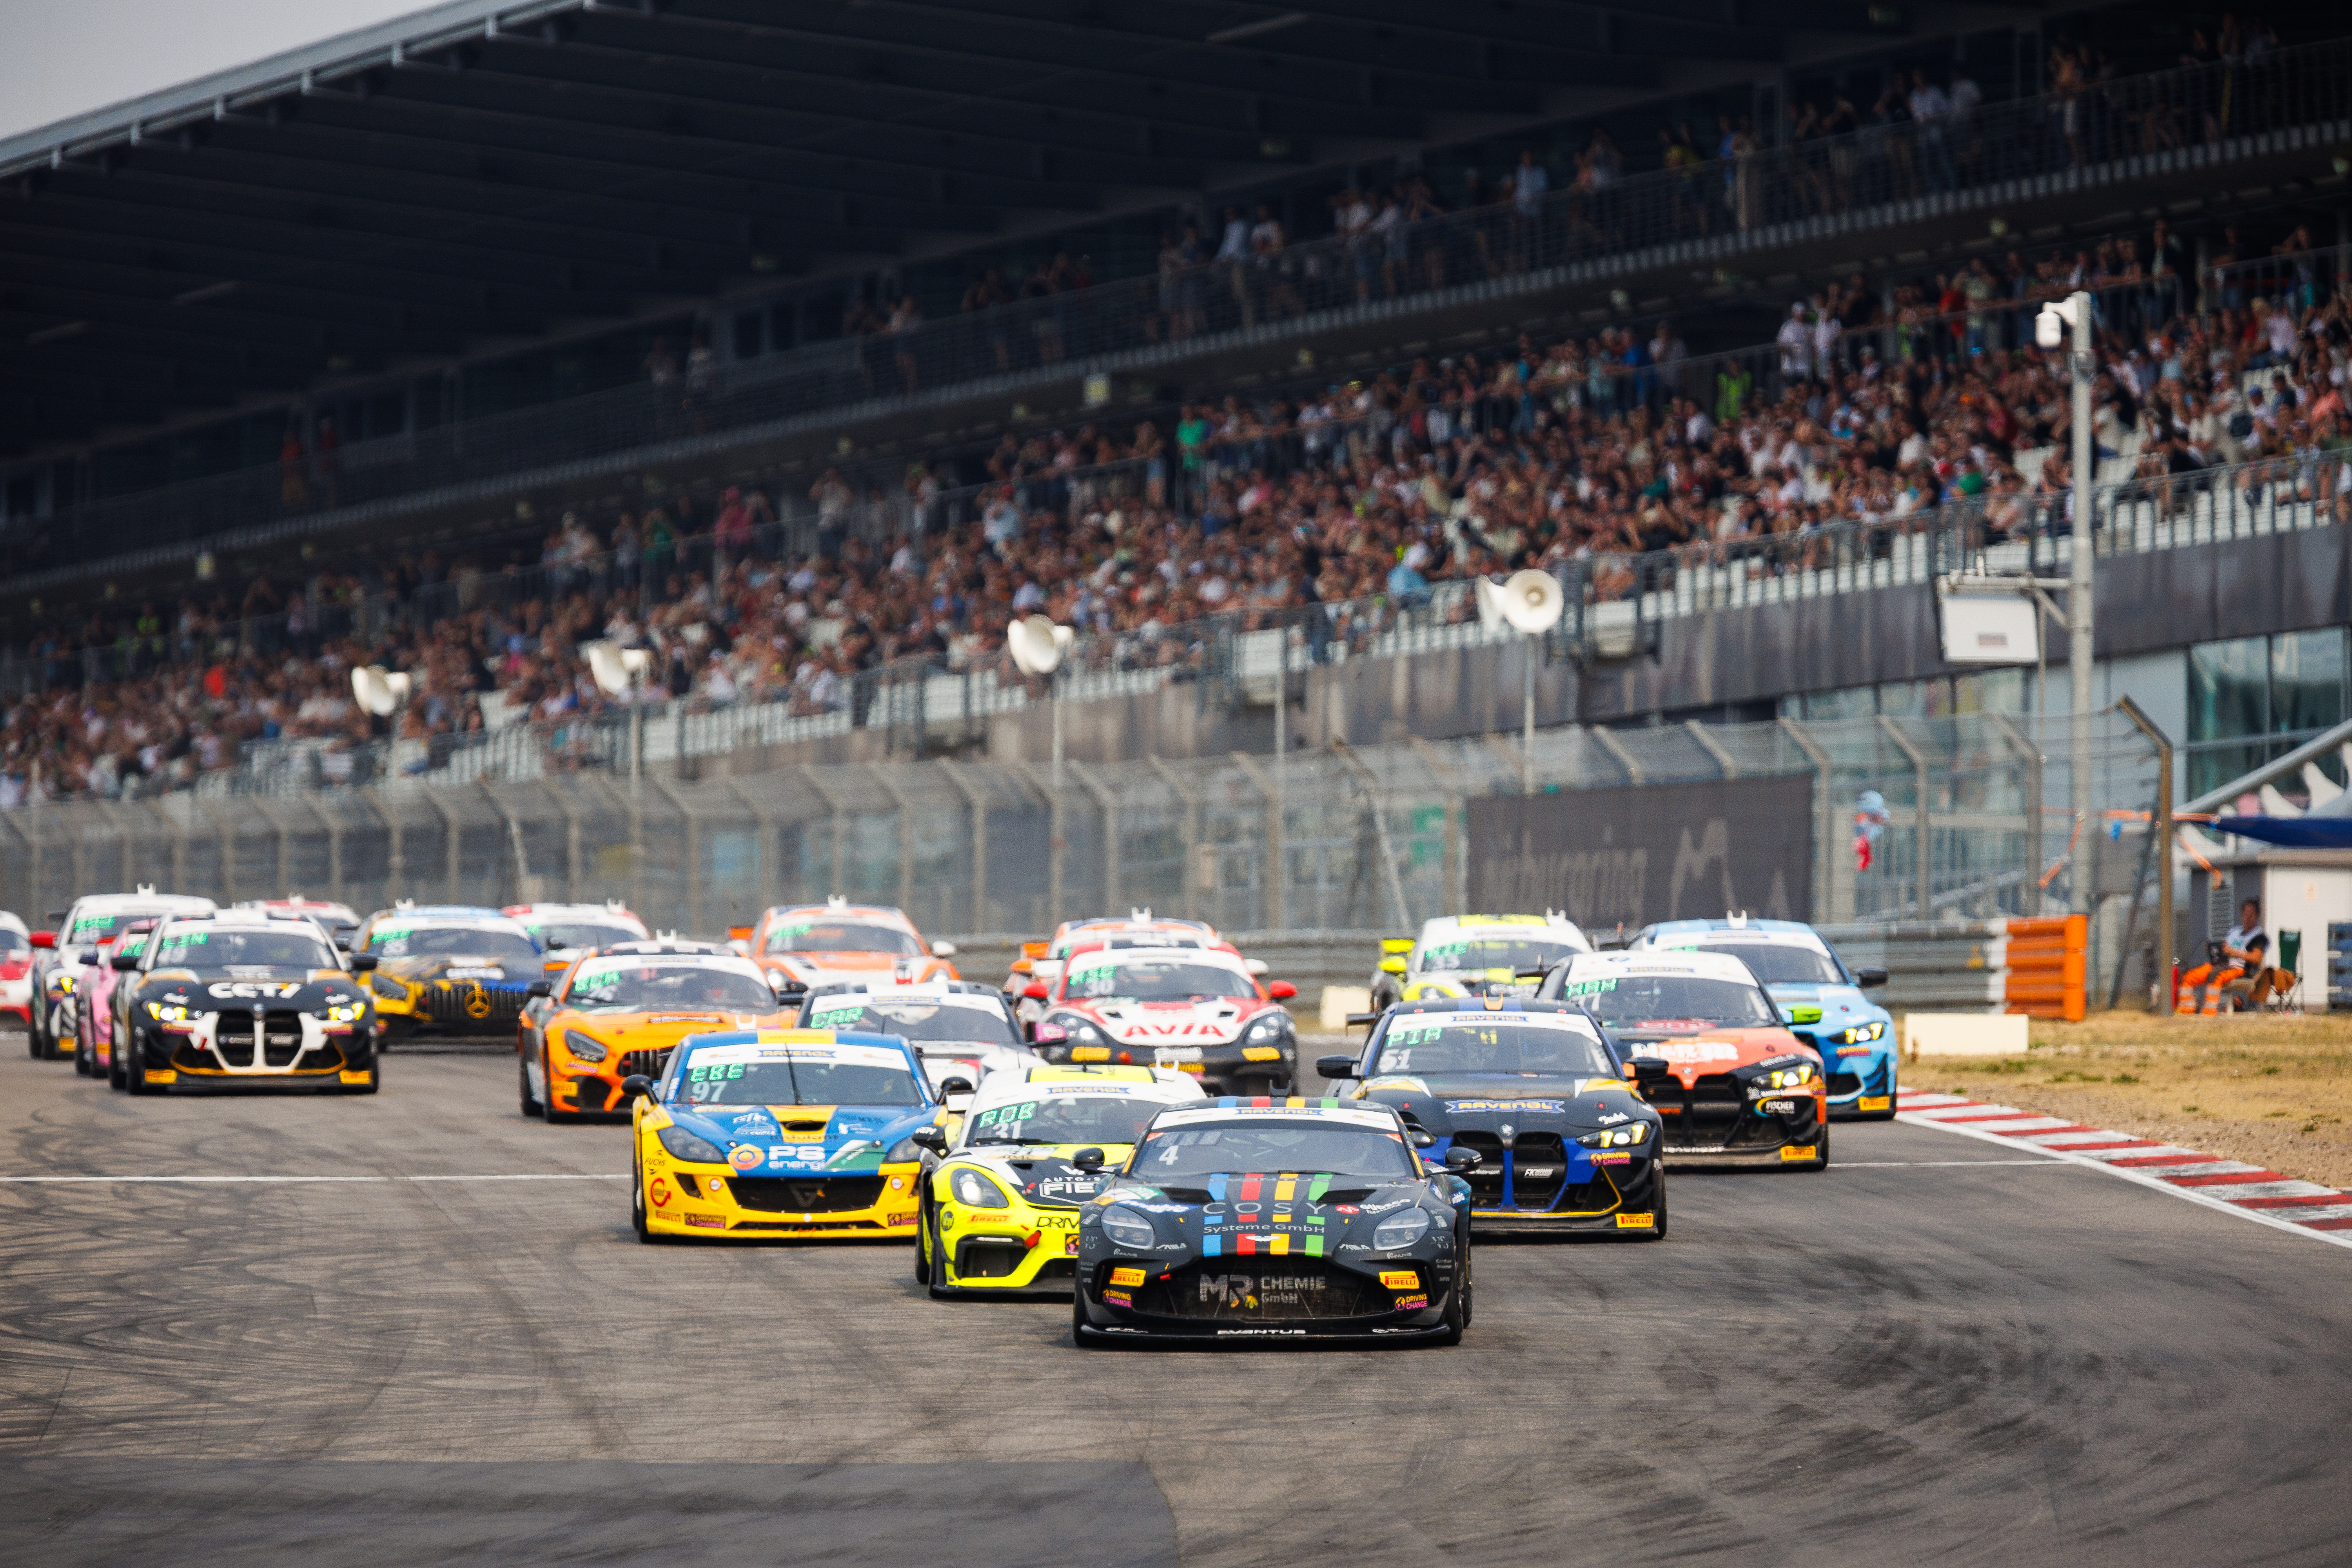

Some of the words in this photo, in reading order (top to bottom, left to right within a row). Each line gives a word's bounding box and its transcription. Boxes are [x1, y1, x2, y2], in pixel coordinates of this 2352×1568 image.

[1567, 978, 1617, 998] HAH
[811, 1007, 863, 1029] CAR
[1123, 1023, 1225, 1037] AVIA
[1387, 1027, 1442, 1047] PIA
[1378, 1049, 1412, 1073] 51
[691, 1081, 727, 1103] 97
[1458, 1101, 1553, 1110] RAVENOL
[1766, 1101, 1794, 1111] FISCHER
[979, 1102, 1036, 1128] ROB
[992, 1120, 1022, 1139] 31
[769, 1145, 826, 1161] PS
[1159, 1145, 1179, 1166] 4
[644, 1157, 666, 1167] FUCHS
[769, 1161, 825, 1171] energi
[1202, 1202, 1327, 1214] COSY
[656, 1210, 681, 1222] PIRELLI
[971, 1214, 1009, 1222] PIRELLI
[1620, 1215, 1651, 1224] PIRELLI
[695, 1220, 725, 1229] CHANGE
[1203, 1224, 1270, 1234] Systeme
[1275, 1224, 1325, 1233] GmbH
[1111, 1270, 1141, 1283] PIRELLI
[1385, 1275, 1416, 1286] PIRELLI
[1200, 1274, 1253, 1302] MR
[1261, 1276, 1325, 1290] CHEMIE
[1109, 1289, 1132, 1301] DRIVING
[1261, 1292, 1298, 1303] GmbH
[1406, 1294, 1427, 1303] DRIVING
[1109, 1295, 1132, 1308] CHANGE
[1406, 1300, 1428, 1310] CHANGE
